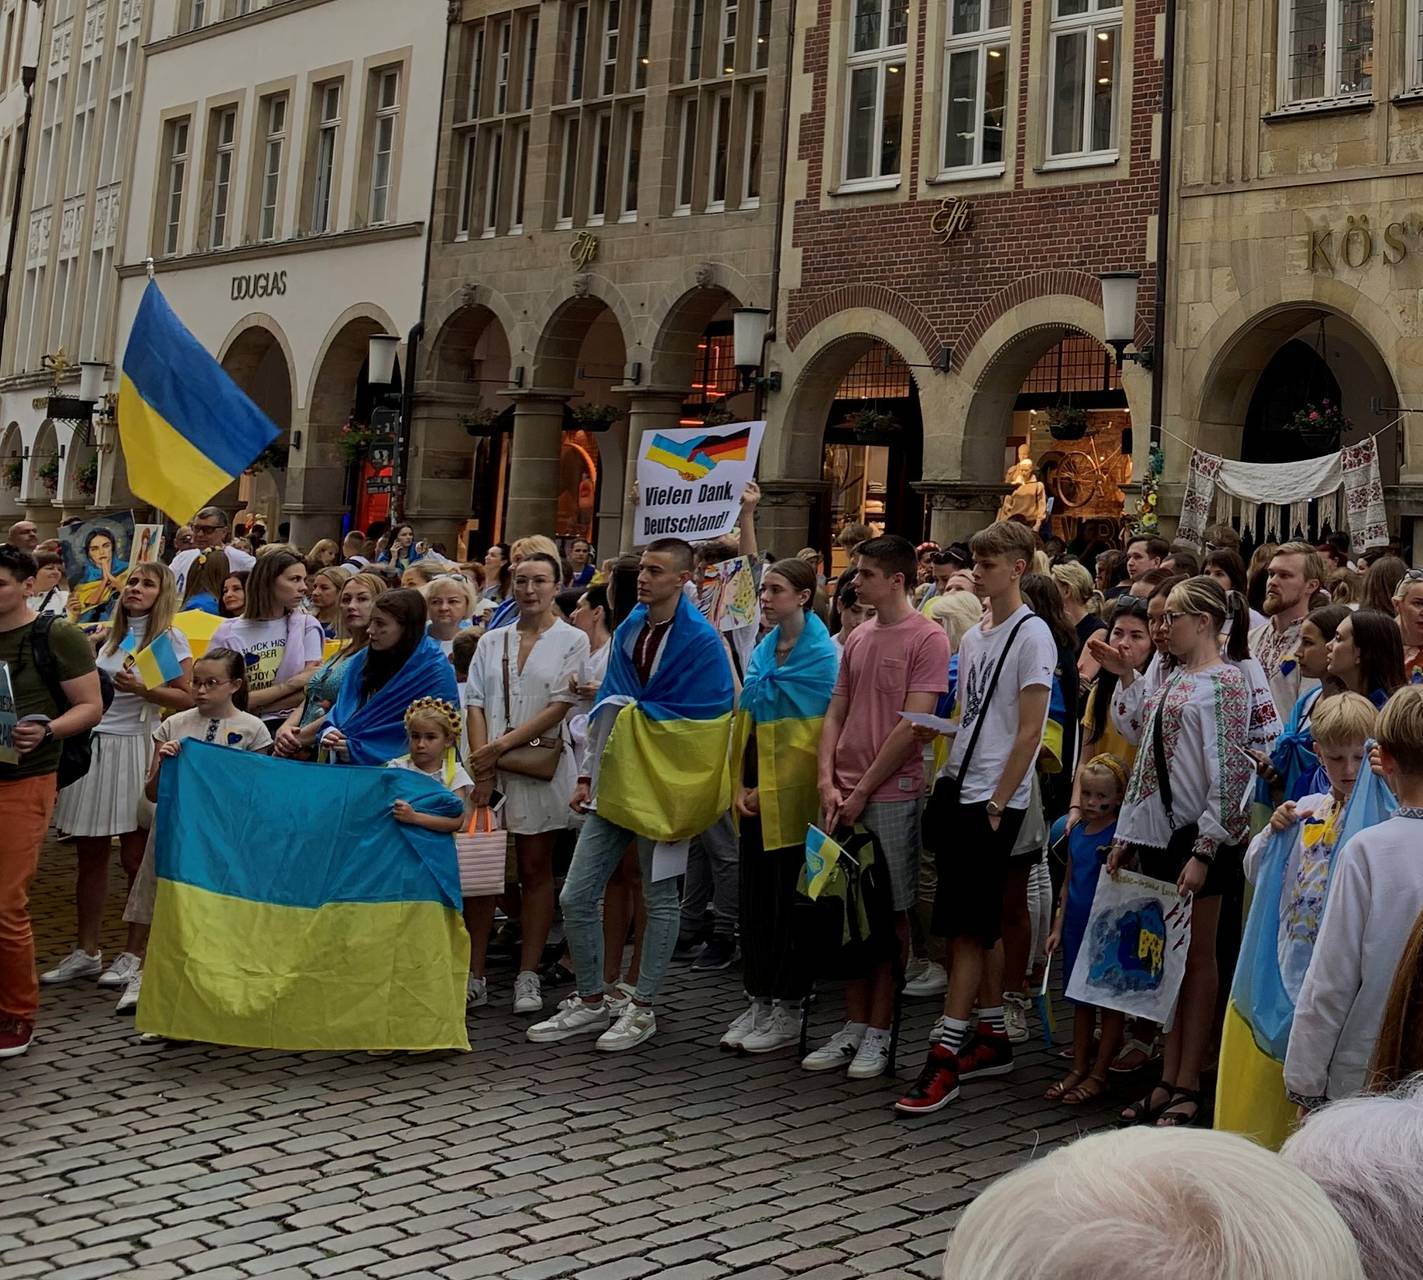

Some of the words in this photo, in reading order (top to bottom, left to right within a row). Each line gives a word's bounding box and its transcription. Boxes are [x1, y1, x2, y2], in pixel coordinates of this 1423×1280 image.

[231, 270, 287, 301] DOUGLAS
[645, 486, 693, 507] Vielen
[697, 480, 734, 503] Dank,
[643, 510, 730, 536] Deutschland!
